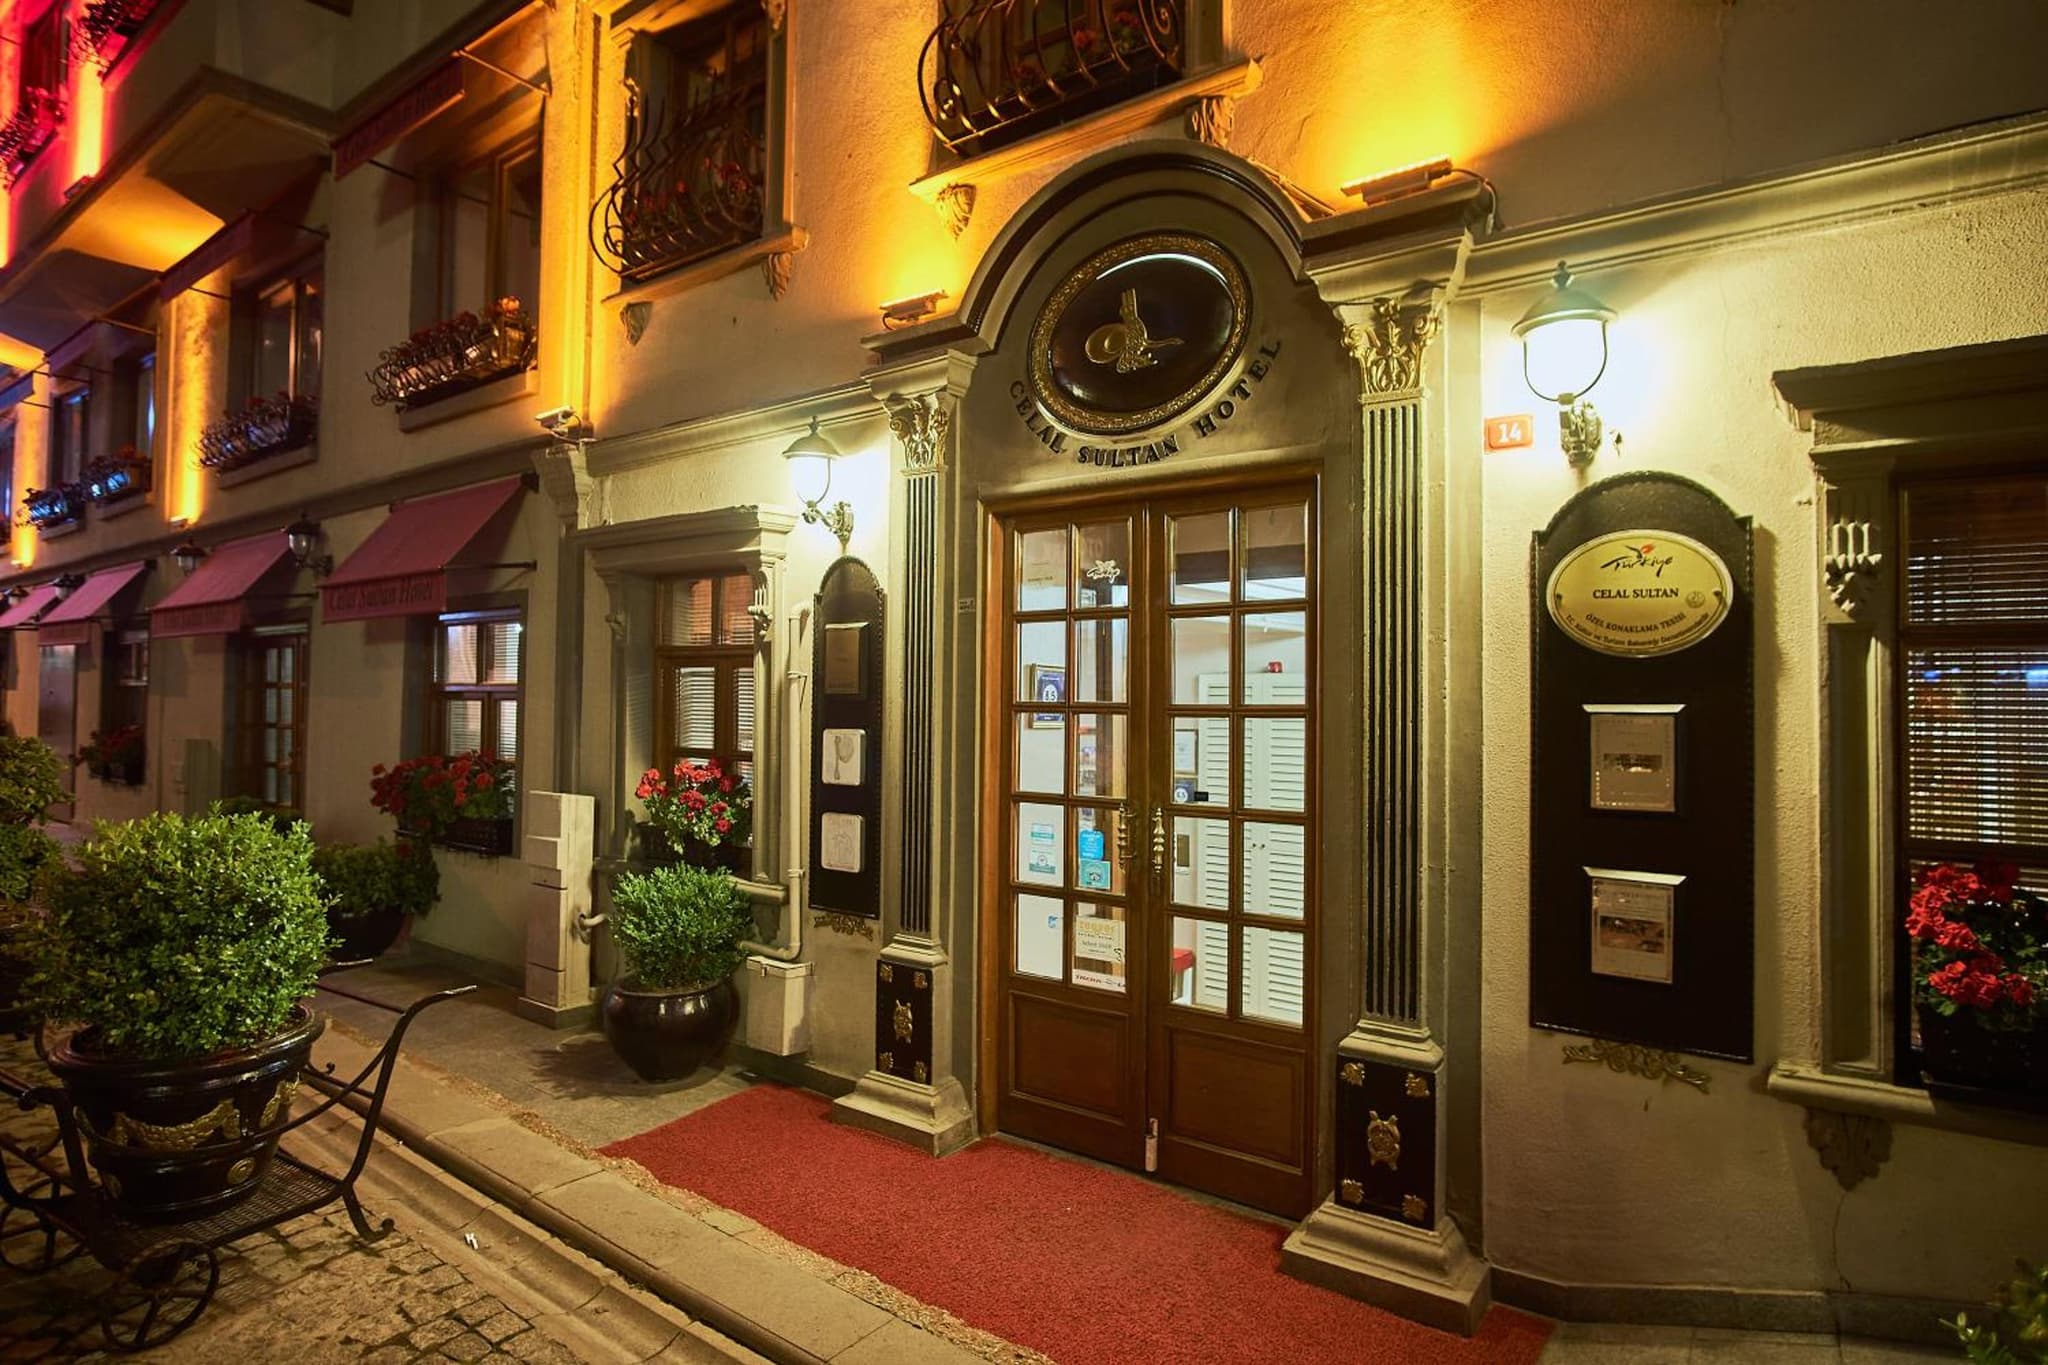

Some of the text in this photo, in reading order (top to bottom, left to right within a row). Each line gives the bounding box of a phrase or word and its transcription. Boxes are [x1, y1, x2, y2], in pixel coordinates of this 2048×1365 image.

[1009, 339, 1281, 467] CELAL SULTAN HOTEL
[1498, 421, 1522, 443] 14
[1592, 587, 1679, 599] CELAL SULTAN
